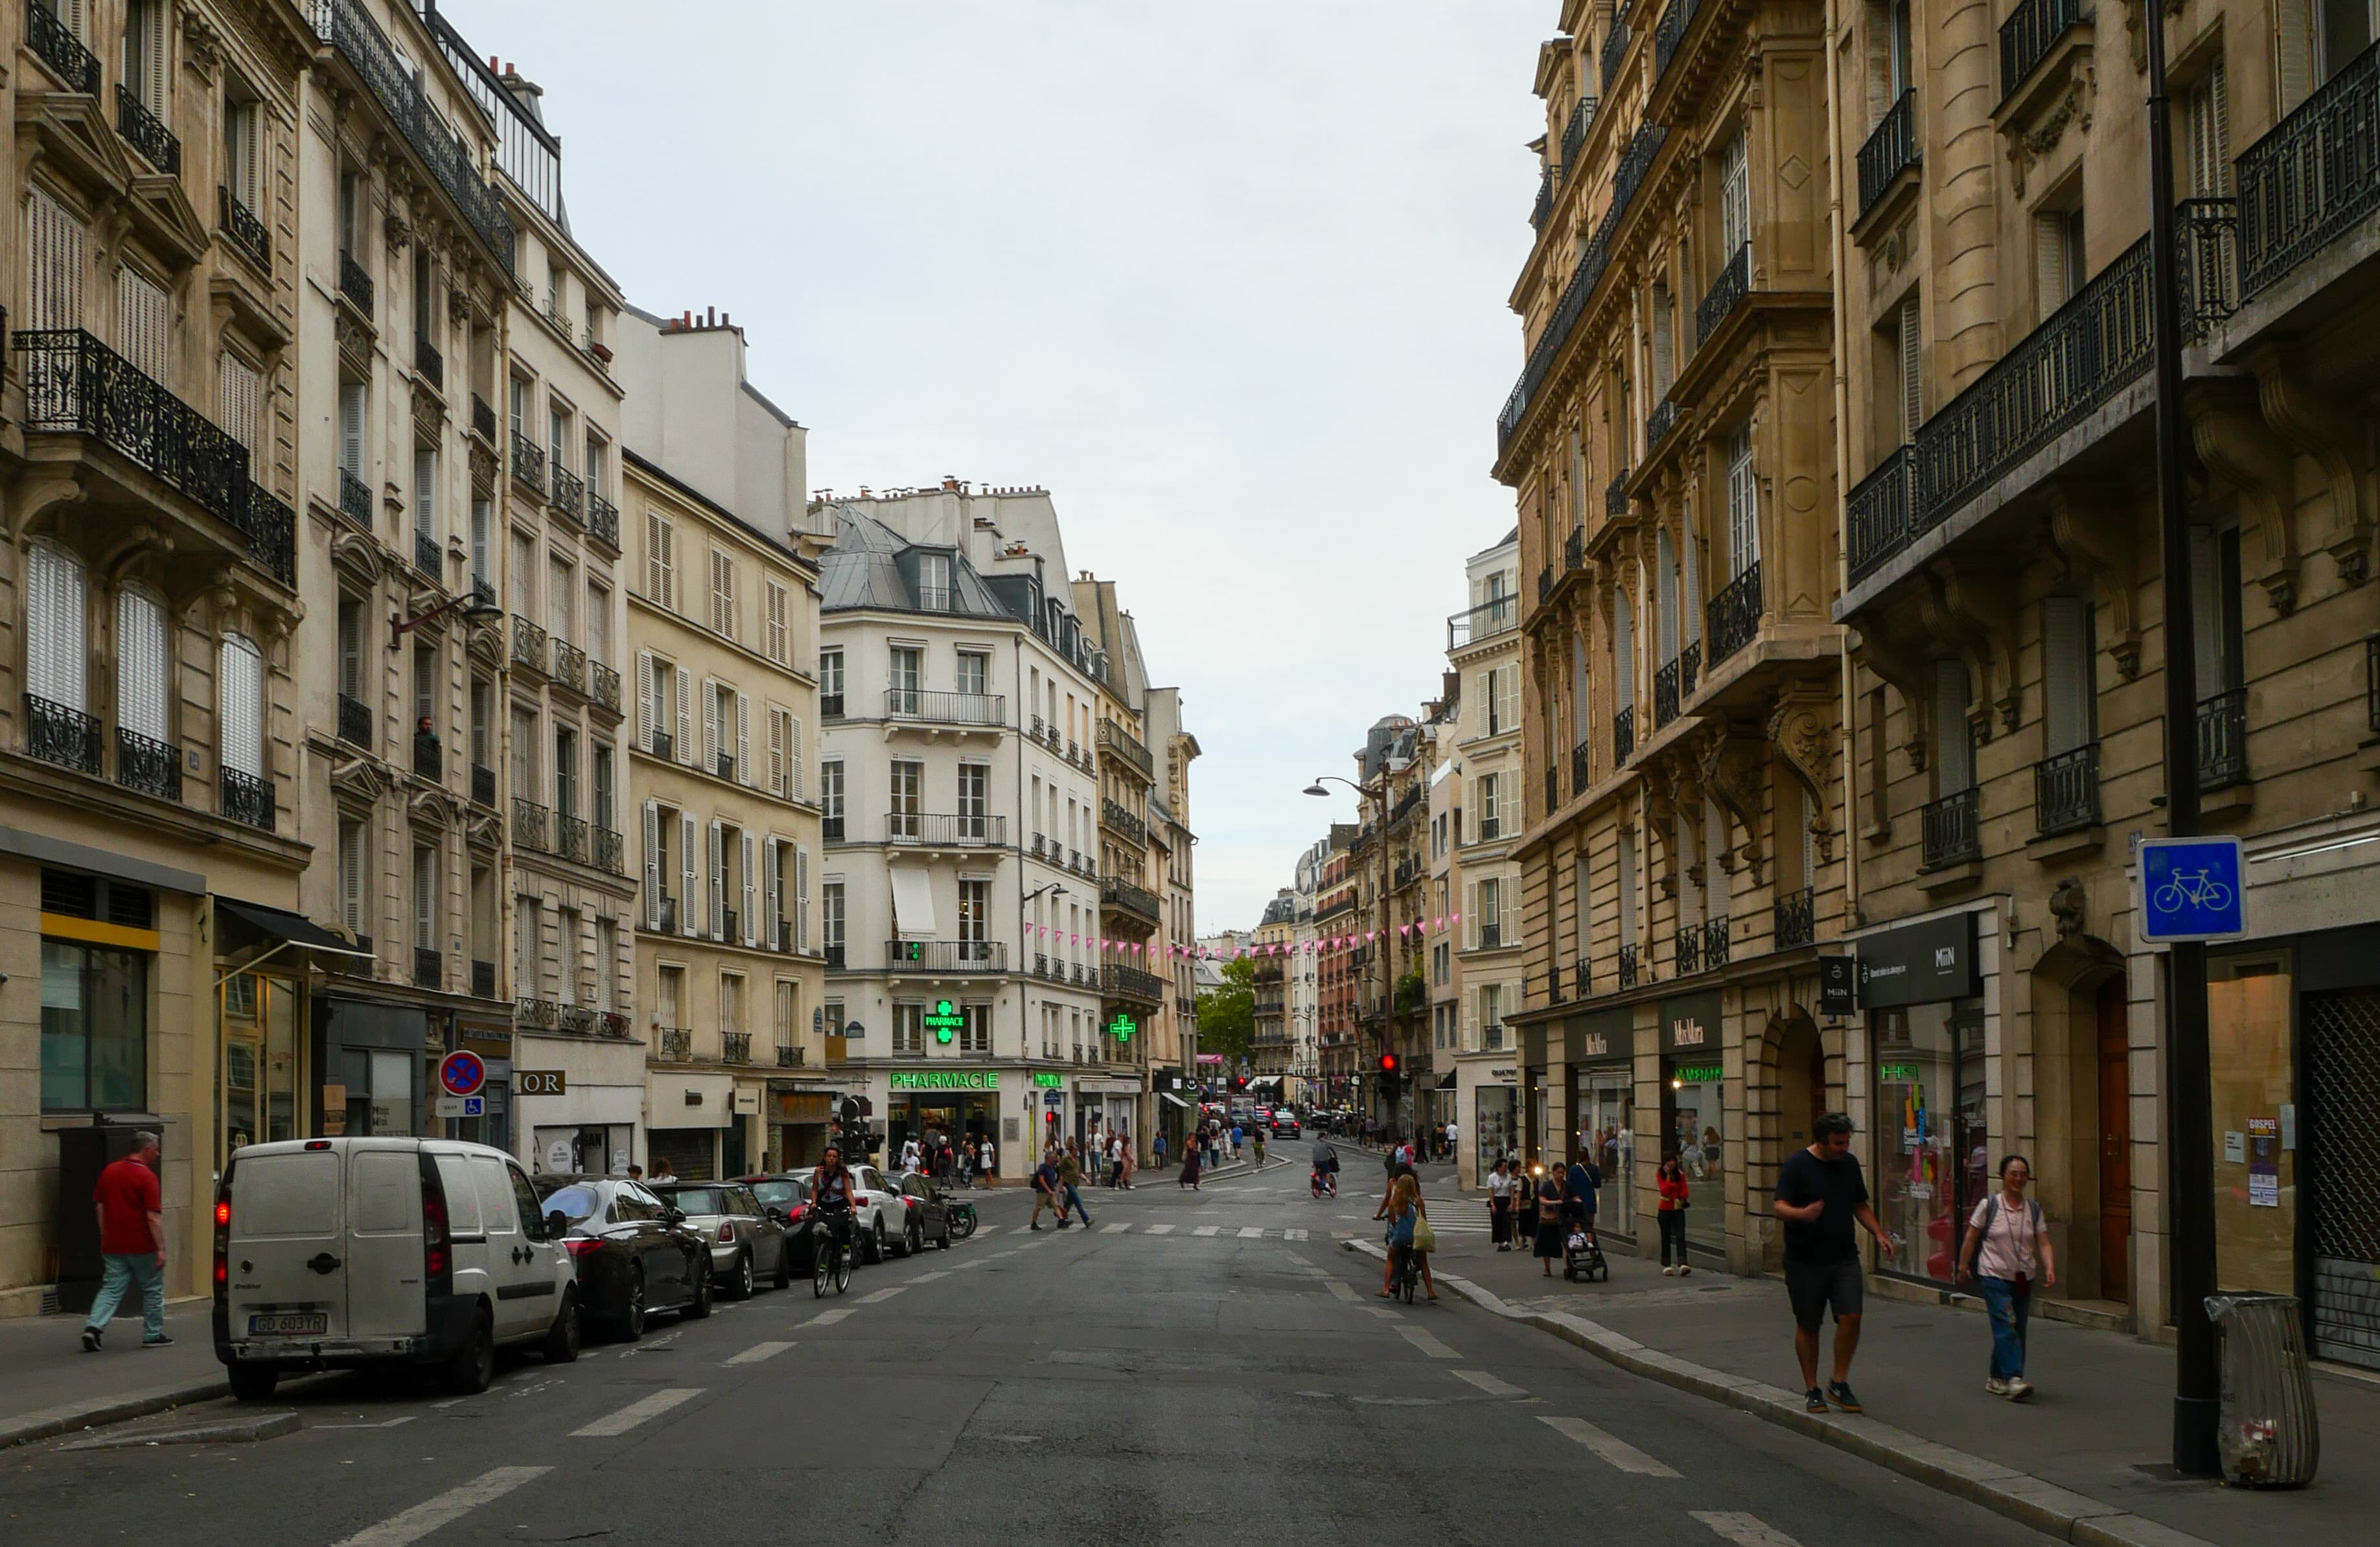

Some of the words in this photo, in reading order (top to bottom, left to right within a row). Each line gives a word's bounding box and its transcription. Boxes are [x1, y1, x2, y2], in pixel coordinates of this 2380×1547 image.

[1935, 946, 1954, 968] MiiN
[1827, 988, 1847, 997] MiiN
[926, 1017, 964, 1026] PHARMACIE
[524, 1074, 560, 1091] OR
[890, 1073, 999, 1088] PHARMACIE
[2250, 1119, 2276, 1129] GOSPEL
